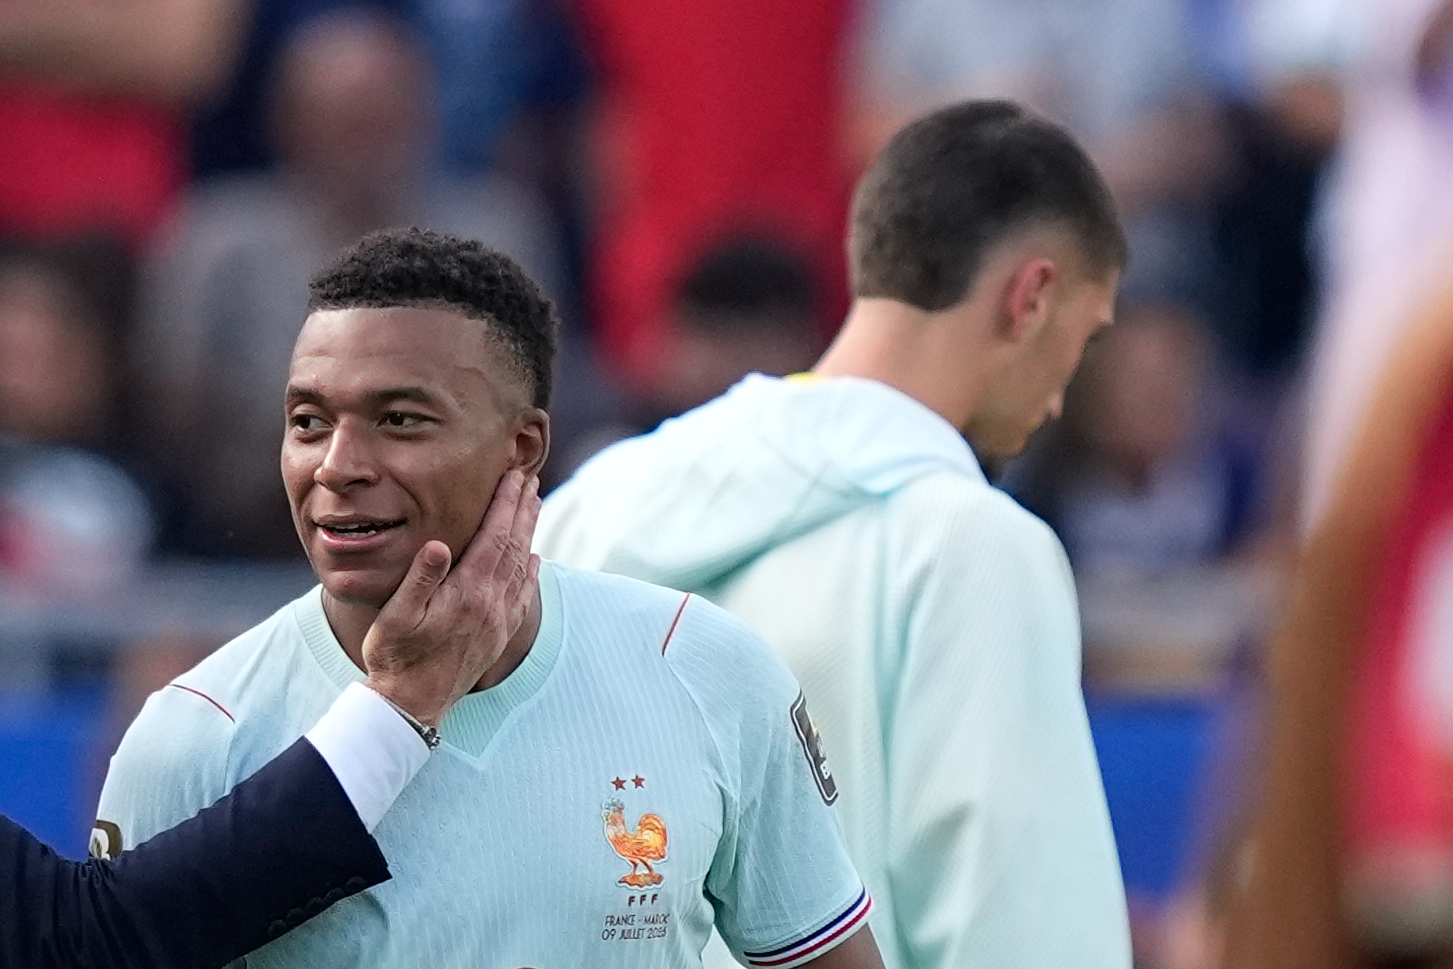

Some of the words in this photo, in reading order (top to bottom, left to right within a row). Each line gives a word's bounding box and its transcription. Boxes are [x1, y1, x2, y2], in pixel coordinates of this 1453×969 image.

[604, 914, 636, 927] FRANCE
[644, 913, 670, 925] MAROC
[601, 928, 617, 941] 09
[618, 928, 645, 940] JUILLET
